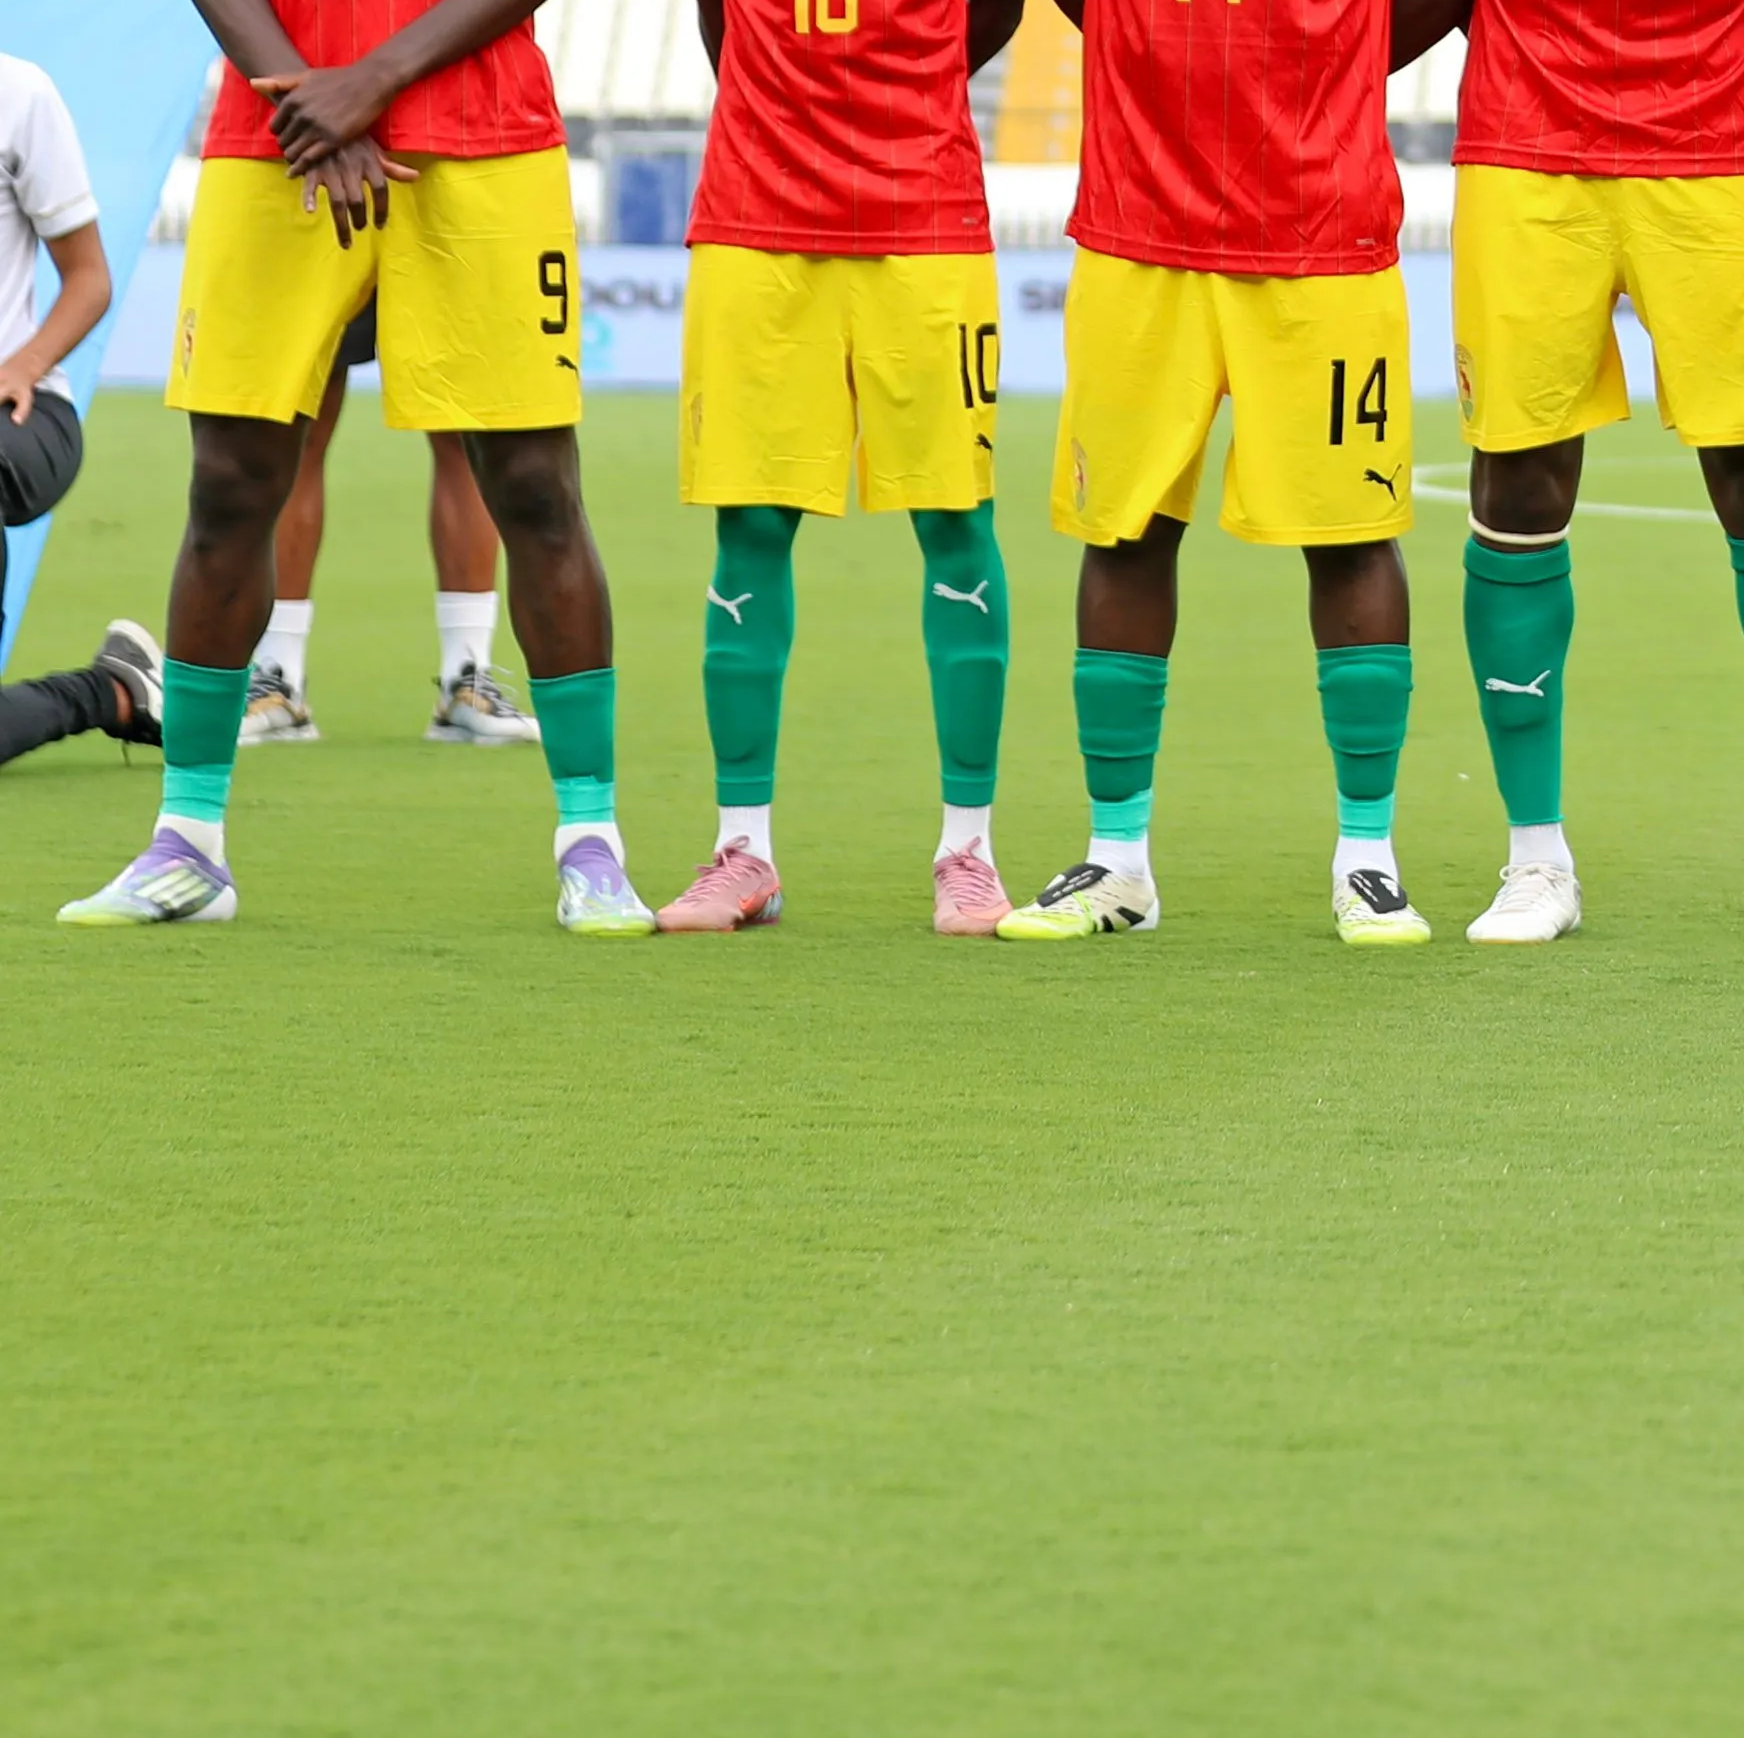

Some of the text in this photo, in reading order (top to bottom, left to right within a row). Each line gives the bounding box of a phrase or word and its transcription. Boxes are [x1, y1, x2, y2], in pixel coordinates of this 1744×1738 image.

[538, 251, 568, 335] 9
[959, 324, 998, 409] 10
[1329, 357, 1388, 446] 14
